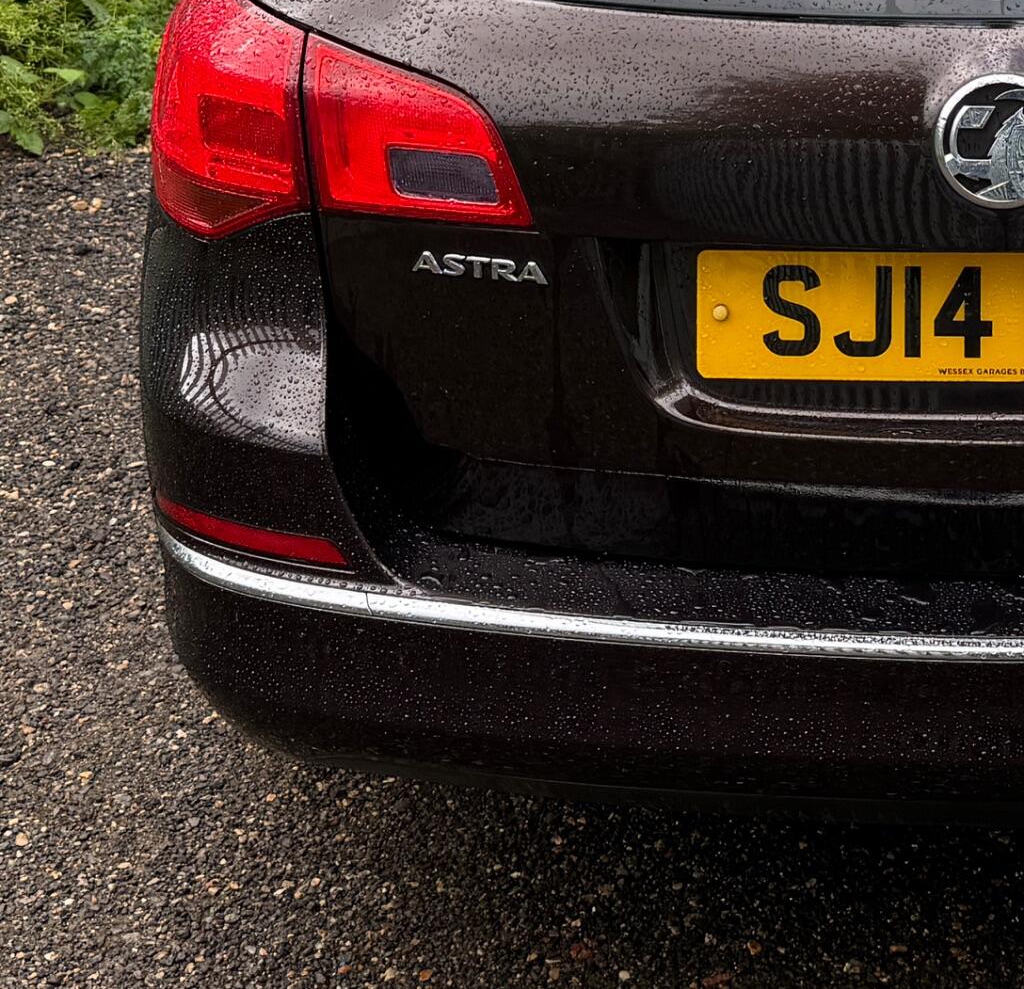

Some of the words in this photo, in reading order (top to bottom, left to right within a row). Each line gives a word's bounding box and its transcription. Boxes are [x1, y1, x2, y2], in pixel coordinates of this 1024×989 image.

[411, 250, 549, 285] ASTRA
[761, 264, 993, 358] SJ14
[938, 367, 973, 376] WESSEX
[976, 367, 1018, 376] GARAGES
